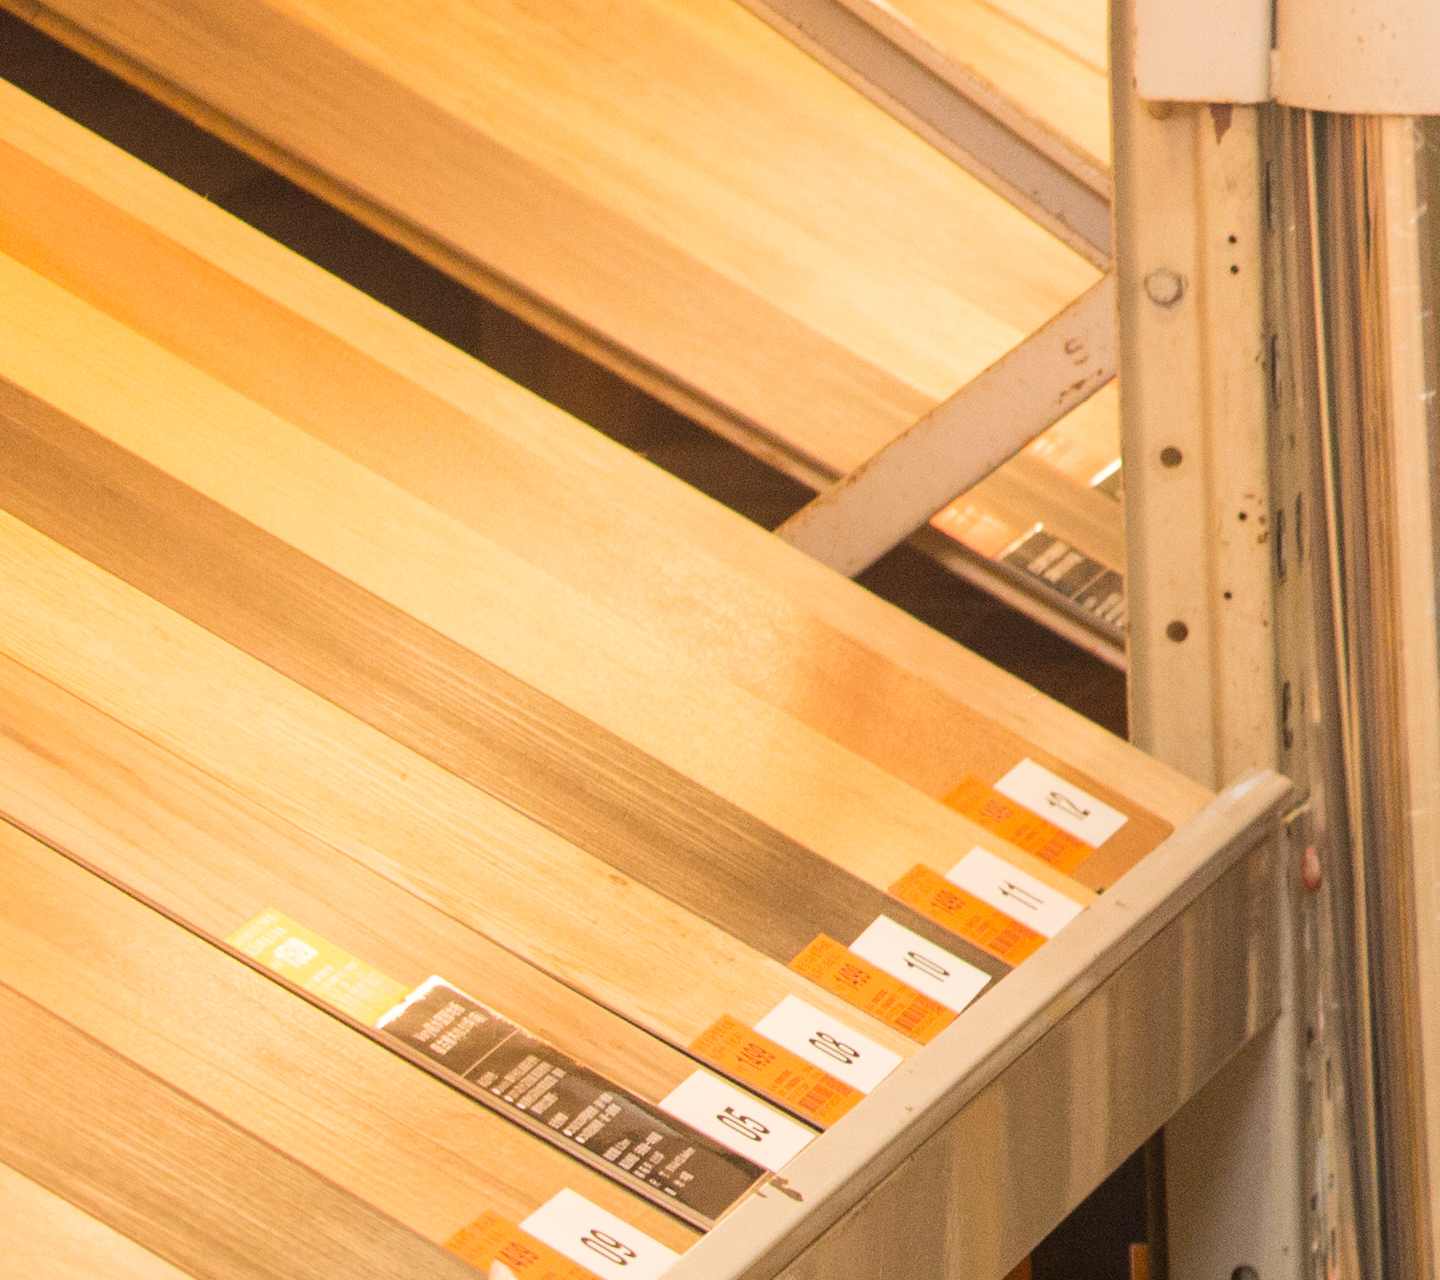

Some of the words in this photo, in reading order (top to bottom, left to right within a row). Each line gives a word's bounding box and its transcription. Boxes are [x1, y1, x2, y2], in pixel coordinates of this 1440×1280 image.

[1046, 791, 1091, 822] 12
[997, 879, 1045, 911] 11
[902, 951, 951, 983] 10
[808, 1031, 860, 1065] 08
[716, 1106, 771, 1142] 05
[580, 1229, 638, 1267] 09
